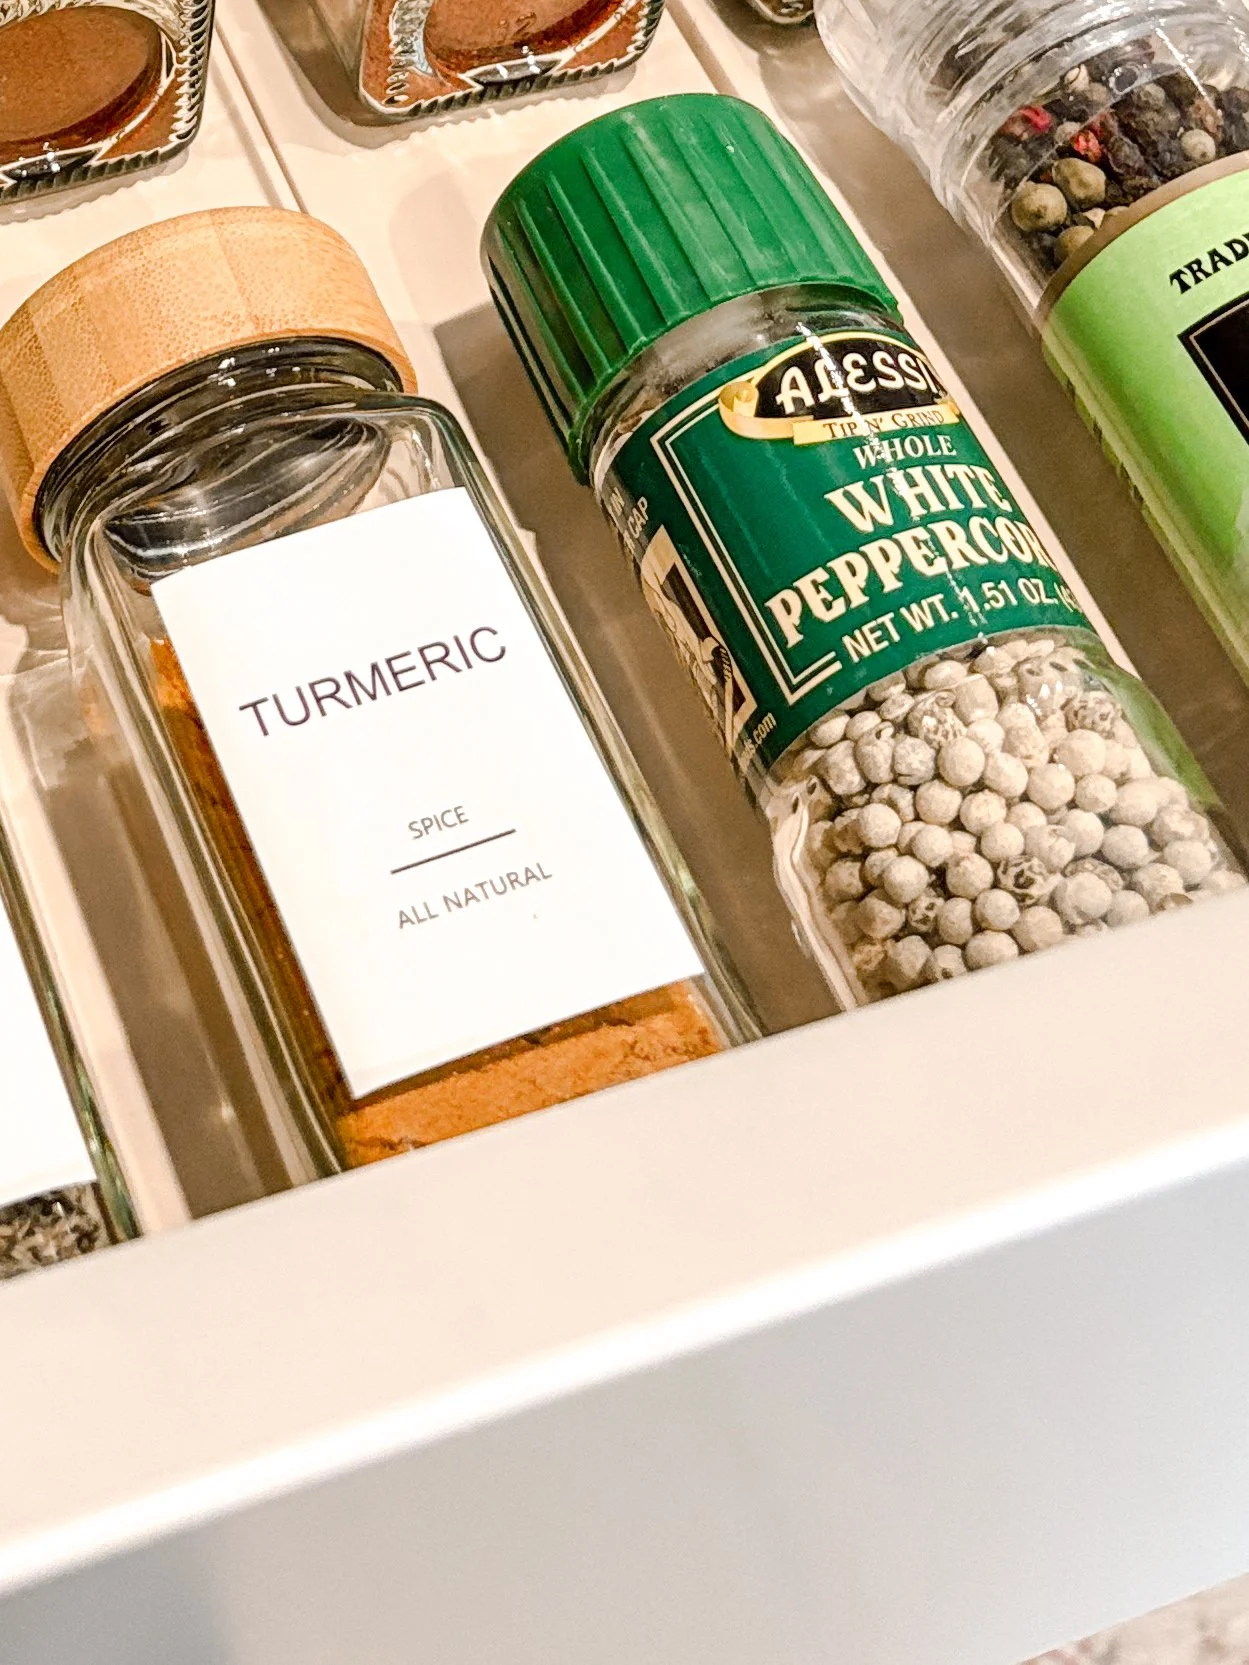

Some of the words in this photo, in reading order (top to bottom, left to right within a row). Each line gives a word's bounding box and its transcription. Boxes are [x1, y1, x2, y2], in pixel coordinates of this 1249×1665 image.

[1169, 232, 1249, 294] TRAD
[775, 350, 938, 415] ALESSI
[823, 418, 862, 438] TIP
[891, 410, 945, 429] GRIND
[853, 434, 957, 470] WHOLE
[627, 496, 649, 539] CAP
[823, 464, 1013, 534] WHITE
[841, 612, 901, 664] NET
[900, 594, 959, 633] WT.
[960, 579, 1018, 615] 1.51
[1017, 577, 1059, 605] OZ.
[238, 625, 507, 737] TURMERIC
[408, 805, 470, 841] SPICE
[397, 901, 439, 929] ALL
[442, 862, 553, 913] NATURAL
